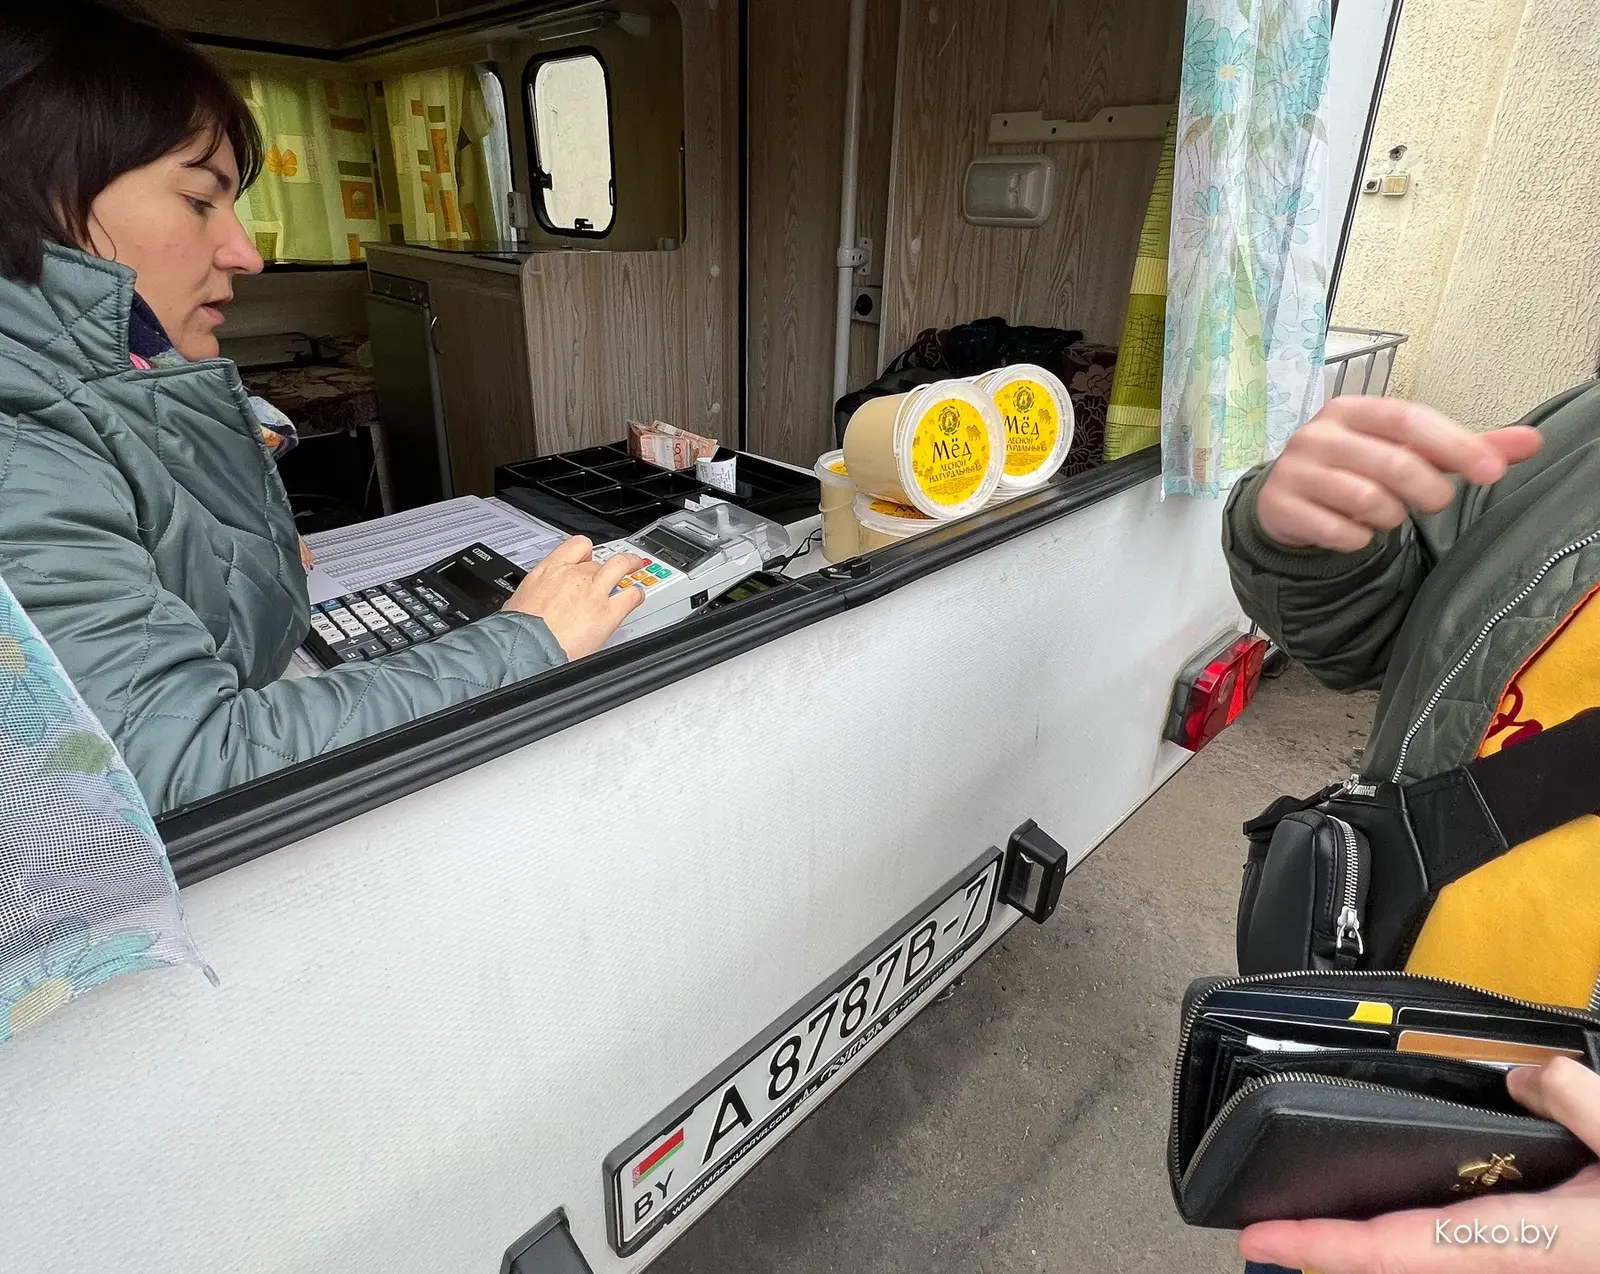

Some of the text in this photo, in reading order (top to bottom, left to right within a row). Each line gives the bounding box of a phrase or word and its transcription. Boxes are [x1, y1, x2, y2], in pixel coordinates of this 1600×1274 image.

[1003, 415, 1040, 440] Мёд
[674, 443, 681, 455] 5
[932, 437, 972, 463] Мёд
[940, 459, 967, 472] ЛЕСНОЙ
[700, 1083, 754, 1167] A
[634, 1168, 675, 1224] BY
